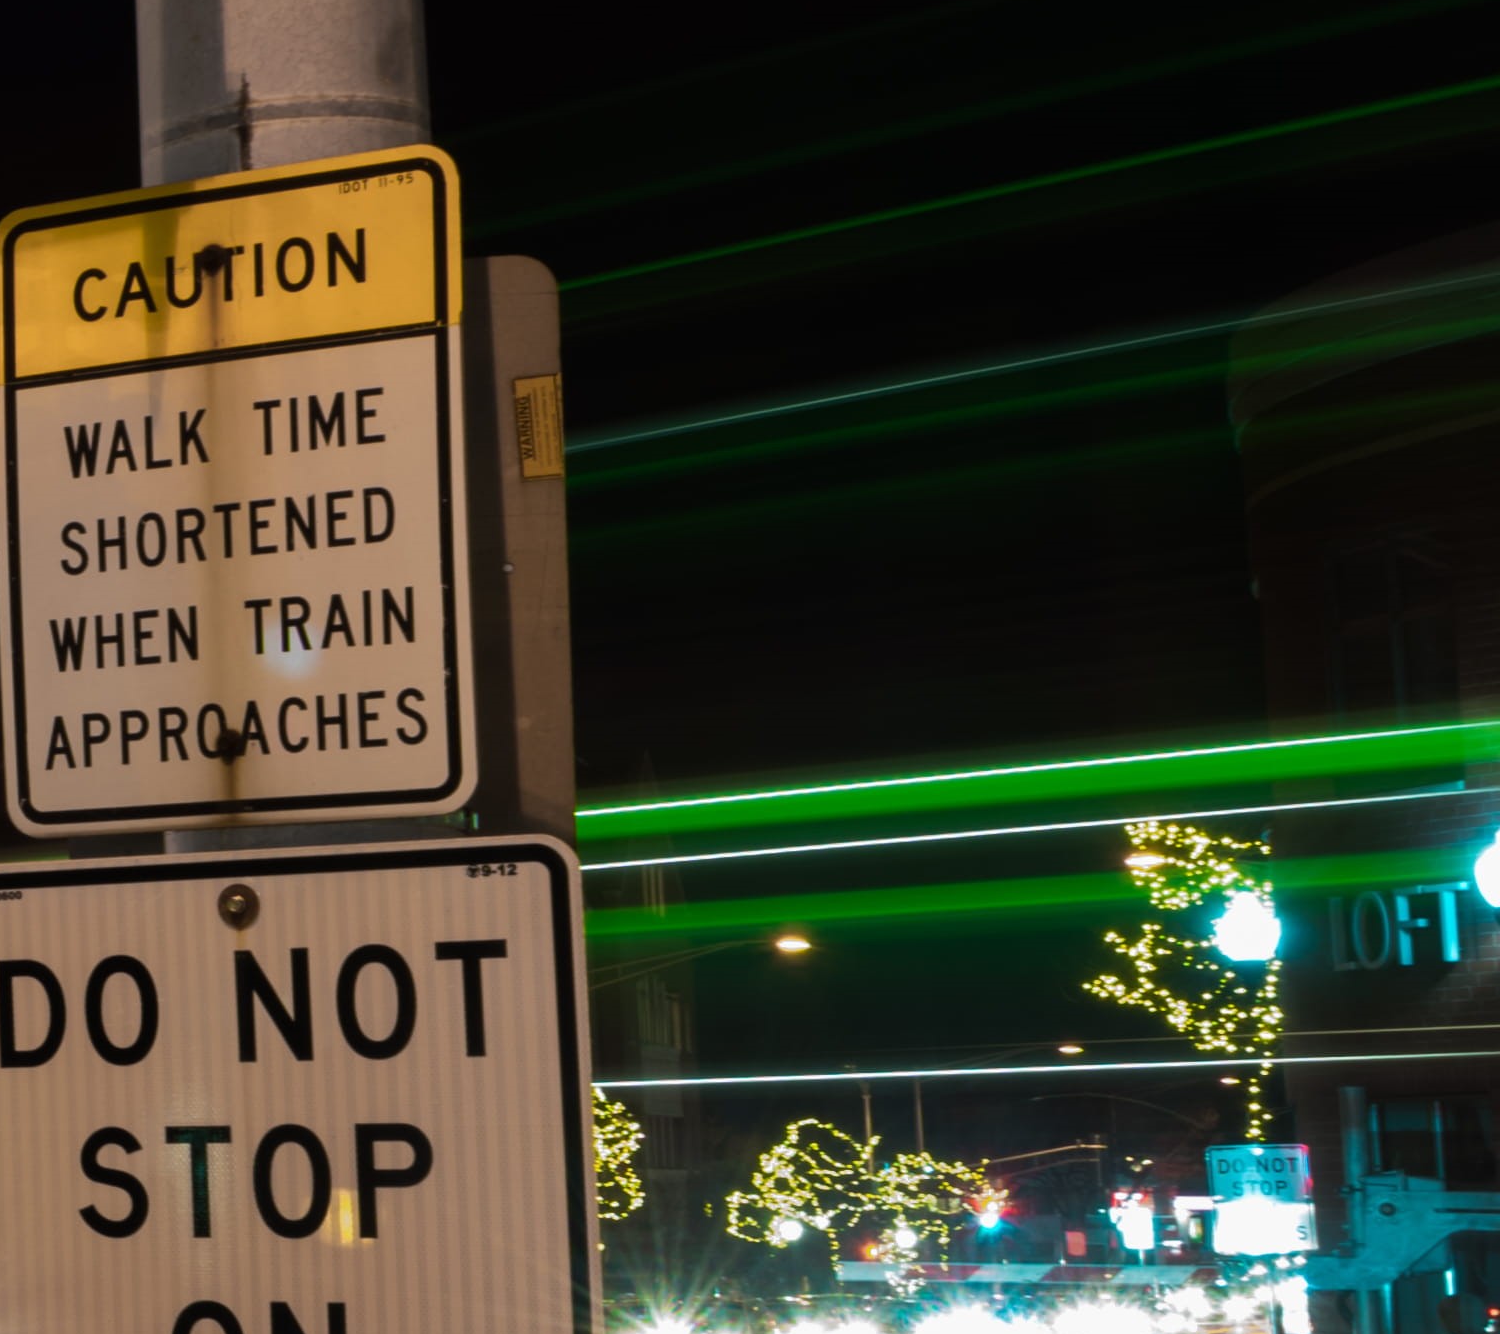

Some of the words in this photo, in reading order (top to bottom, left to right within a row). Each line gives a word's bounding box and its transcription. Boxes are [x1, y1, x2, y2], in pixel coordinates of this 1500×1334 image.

[73, 227, 367, 324] CAUTION
[64, 408, 210, 480] WALK
[253, 387, 387, 457] TIME
[59, 486, 397, 577] SHORTENED
[49, 605, 200, 674] WHEN
[244, 586, 416, 656] TRAIN
[45, 687, 429, 772] APPROACHES
[1328, 880, 1470, 972] LOFT
[232, 938, 509, 1064] NOT
[77, 1121, 434, 1240] STOP
[1216, 1158, 1246, 1175] DO
[1255, 1157, 1299, 1173] NOT
[1231, 1179, 1288, 1197] STOP
